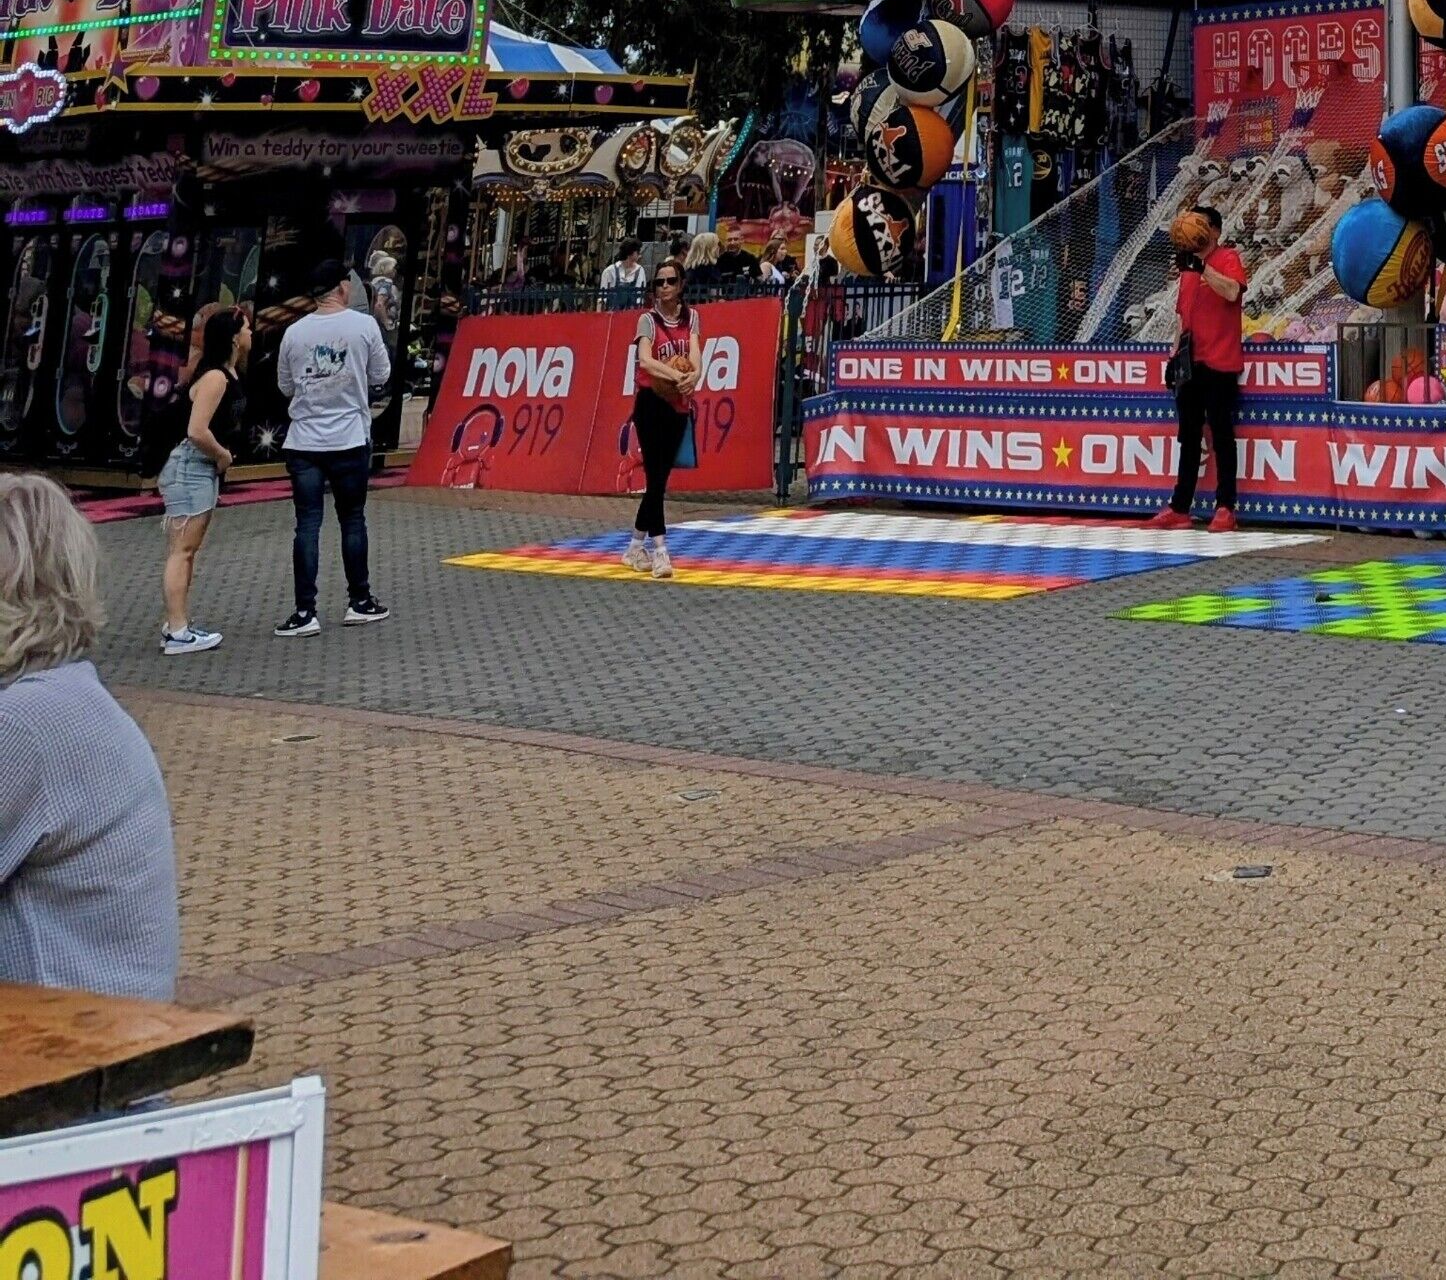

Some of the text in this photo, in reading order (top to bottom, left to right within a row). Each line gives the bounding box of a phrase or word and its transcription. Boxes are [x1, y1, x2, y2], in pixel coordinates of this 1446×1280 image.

[36, 87, 55, 108] BIG
[361, 62, 498, 124] XXL
[207, 137, 462, 164] Win a teddy for your sweetie
[463, 346, 574, 398] nova
[838, 357, 902, 380] ONE
[913, 358, 947, 381] IN
[959, 358, 1053, 383] WINS
[1073, 359, 1148, 385] ONE
[1236, 360, 1322, 387] INS
[507, 403, 565, 457] 919
[816, 424, 868, 467] IN
[885, 426, 1044, 472] WINS
[1080, 434, 1210, 478] ON
